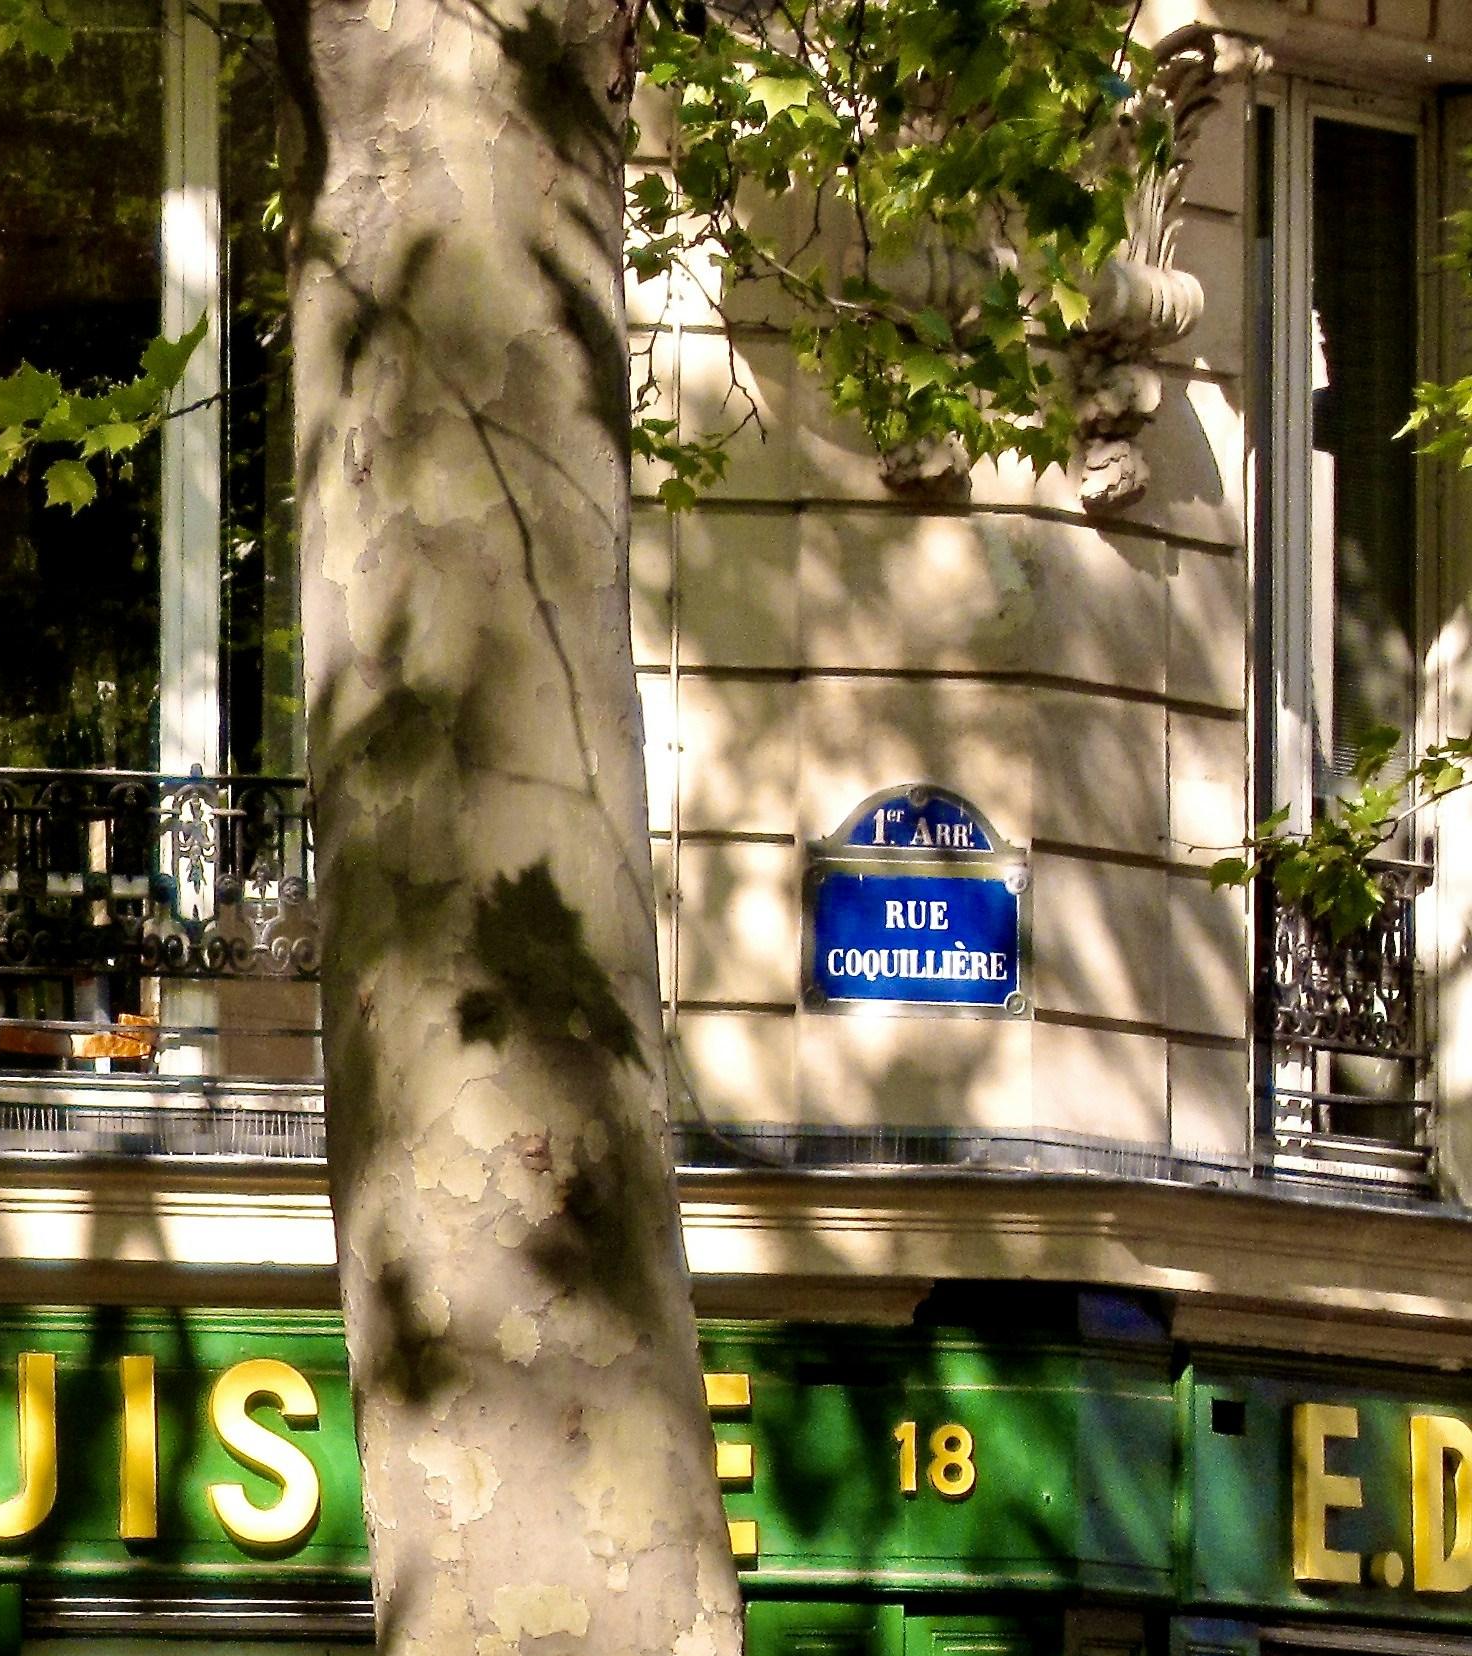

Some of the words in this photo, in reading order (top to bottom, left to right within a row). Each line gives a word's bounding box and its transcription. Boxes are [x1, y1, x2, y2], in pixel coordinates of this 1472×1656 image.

[885, 900, 949, 930] RUE
[827, 941, 1008, 982] COQUILLIÈRE
[893, 1421, 978, 1498] 18
